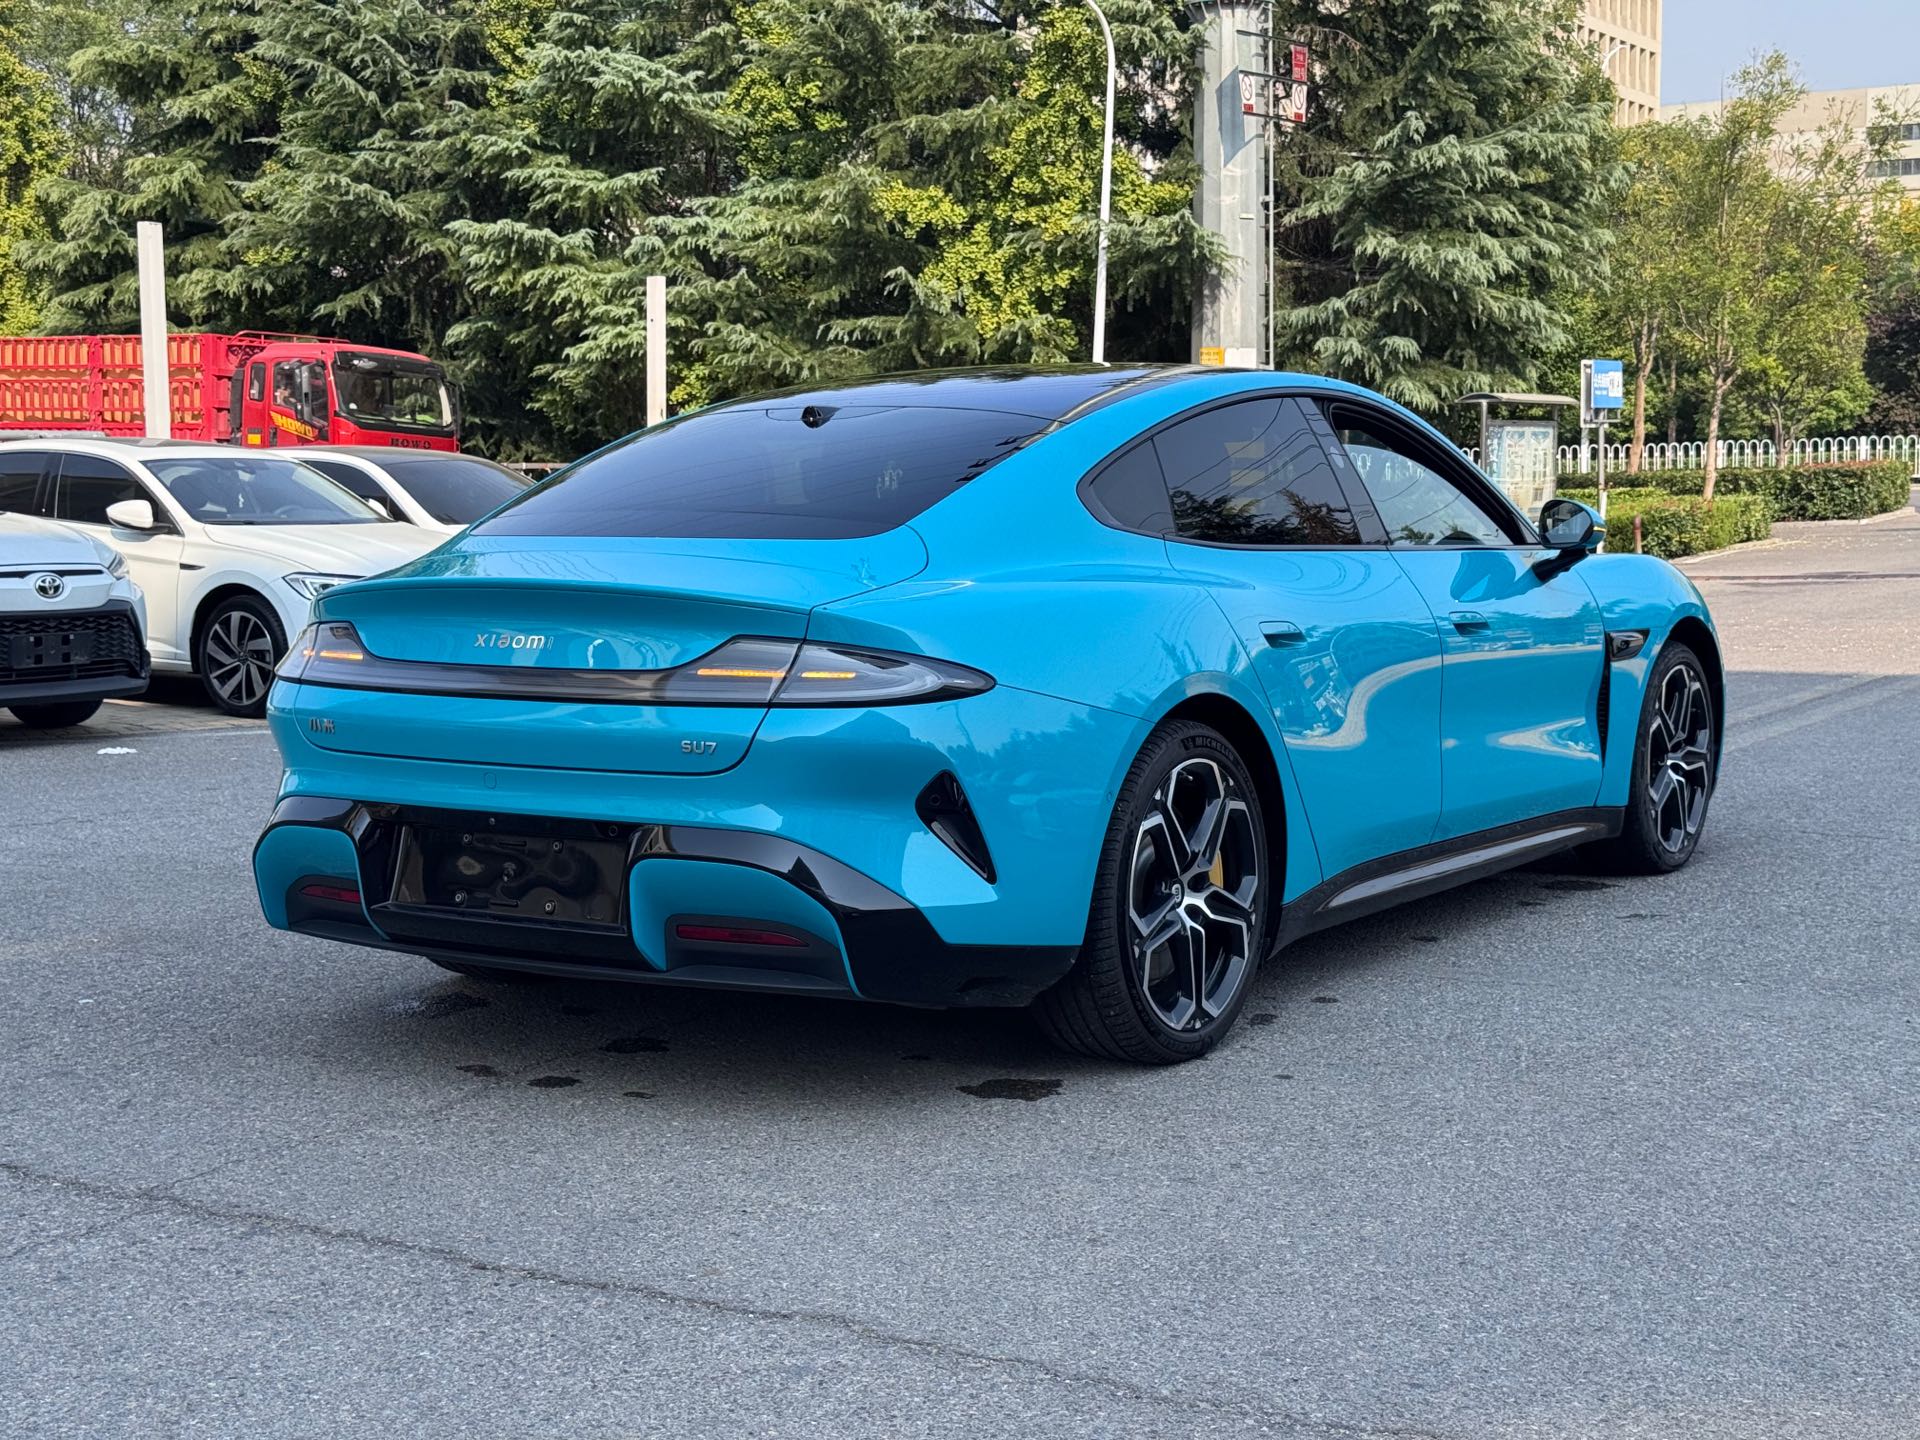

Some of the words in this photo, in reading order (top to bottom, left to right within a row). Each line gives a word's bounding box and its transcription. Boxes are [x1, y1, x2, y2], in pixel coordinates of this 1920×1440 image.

[279, 414, 313, 437] HOWO
[391, 437, 431, 449] HOWO
[681, 740, 717, 754] SU7
[1194, 736, 1234, 761] MICHELIN
